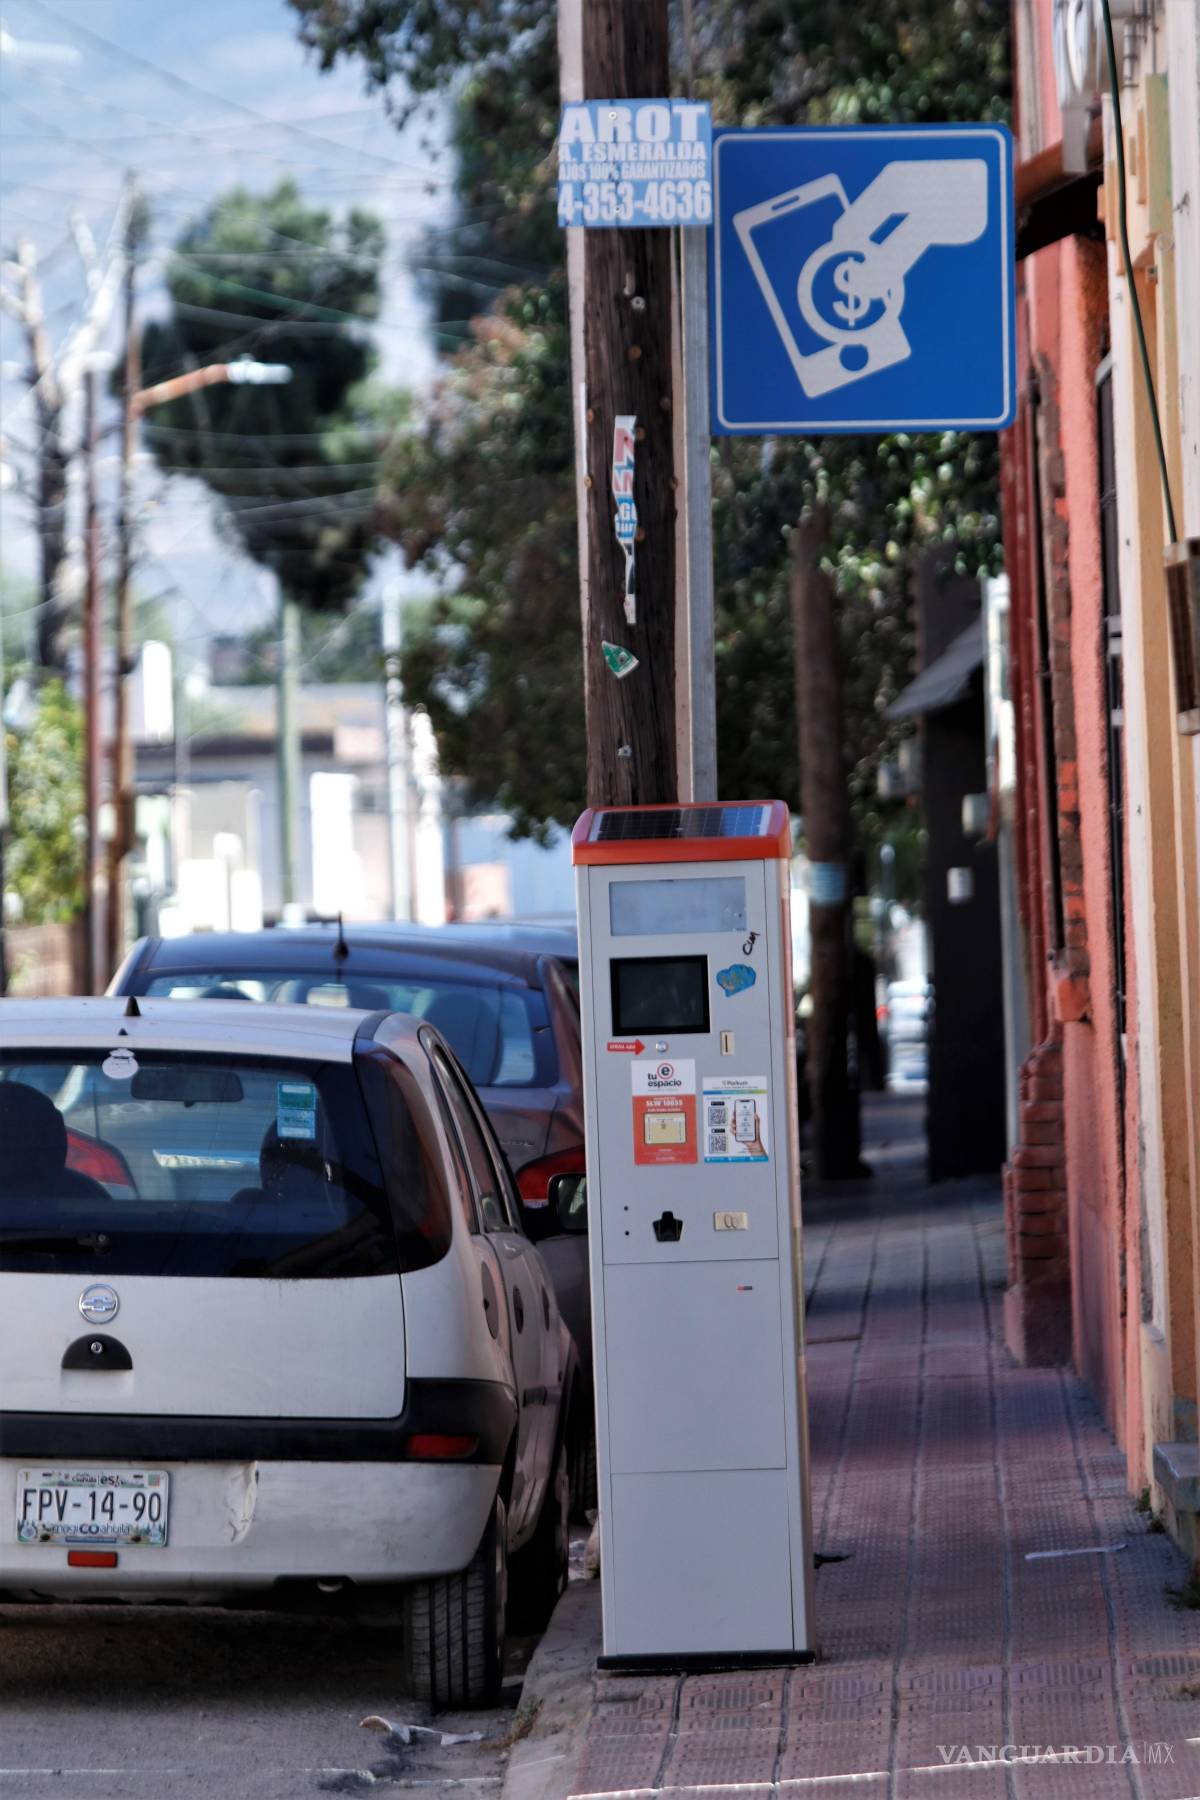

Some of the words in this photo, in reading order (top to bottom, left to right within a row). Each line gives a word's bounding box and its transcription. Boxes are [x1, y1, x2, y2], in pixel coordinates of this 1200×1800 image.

[560, 105, 706, 143] AROT
[582, 141, 706, 162] ESMERALDA
[622, 160, 705, 178] GARANTIZADOS
[558, 180, 711, 222] 4-353-4636
[647, 1079, 682, 1088] espacio
[22, 1489, 162, 1522] FPV-14-90
